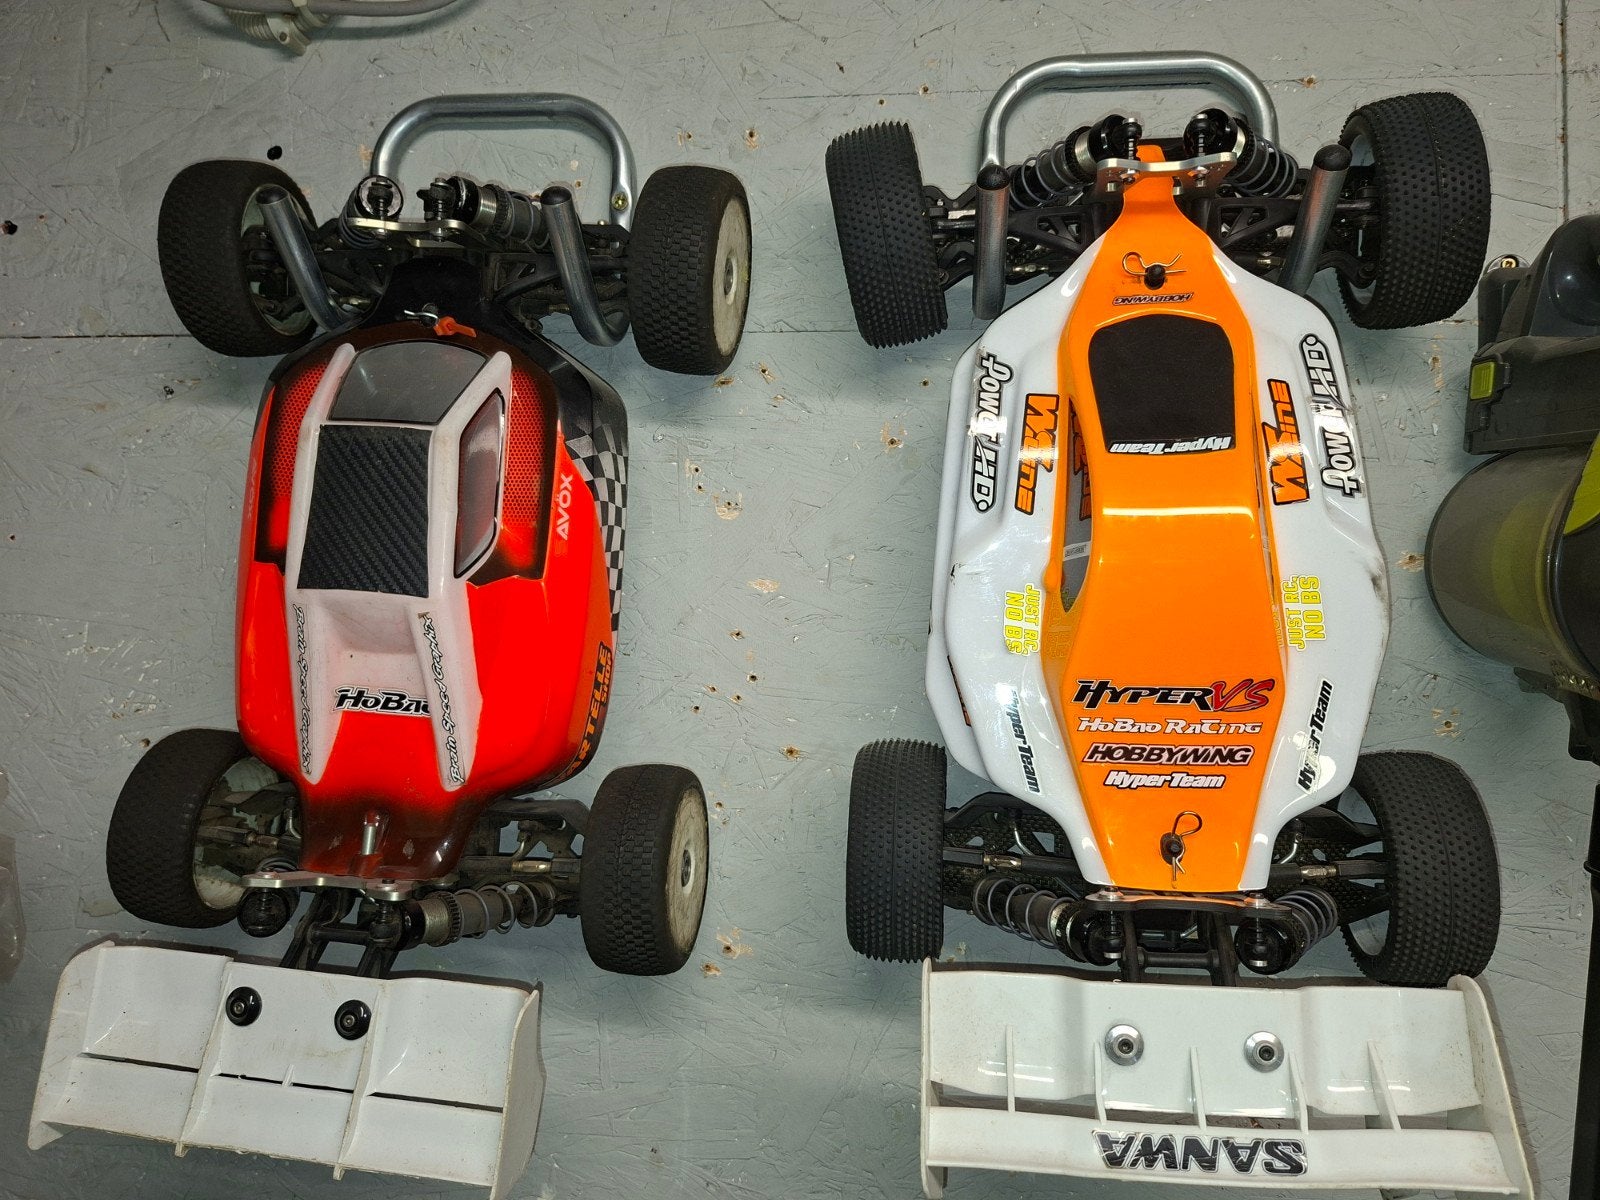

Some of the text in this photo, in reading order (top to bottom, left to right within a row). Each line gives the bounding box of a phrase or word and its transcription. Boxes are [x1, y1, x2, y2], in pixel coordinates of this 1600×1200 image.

[1113, 292, 1193, 306] HOBBYWING
[1110, 436, 1231, 455] Hyper Team
[1005, 592, 1024, 653] NO BS
[1025, 585, 1040, 626] JUST
[1285, 607, 1305, 649] JUST
[1299, 576, 1325, 639] NO BS
[424, 613, 465, 782] Brain Speed Graphix
[600, 650, 612, 704] SHOP
[558, 642, 607, 782] ARTELLE
[1310, 680, 1332, 732] Team
[1018, 745, 1040, 793] Team
[1084, 743, 1253, 765] HOBBYWING
[1104, 770, 1225, 788] Hyper Team
[1094, 1131, 1307, 1174] SANWA
